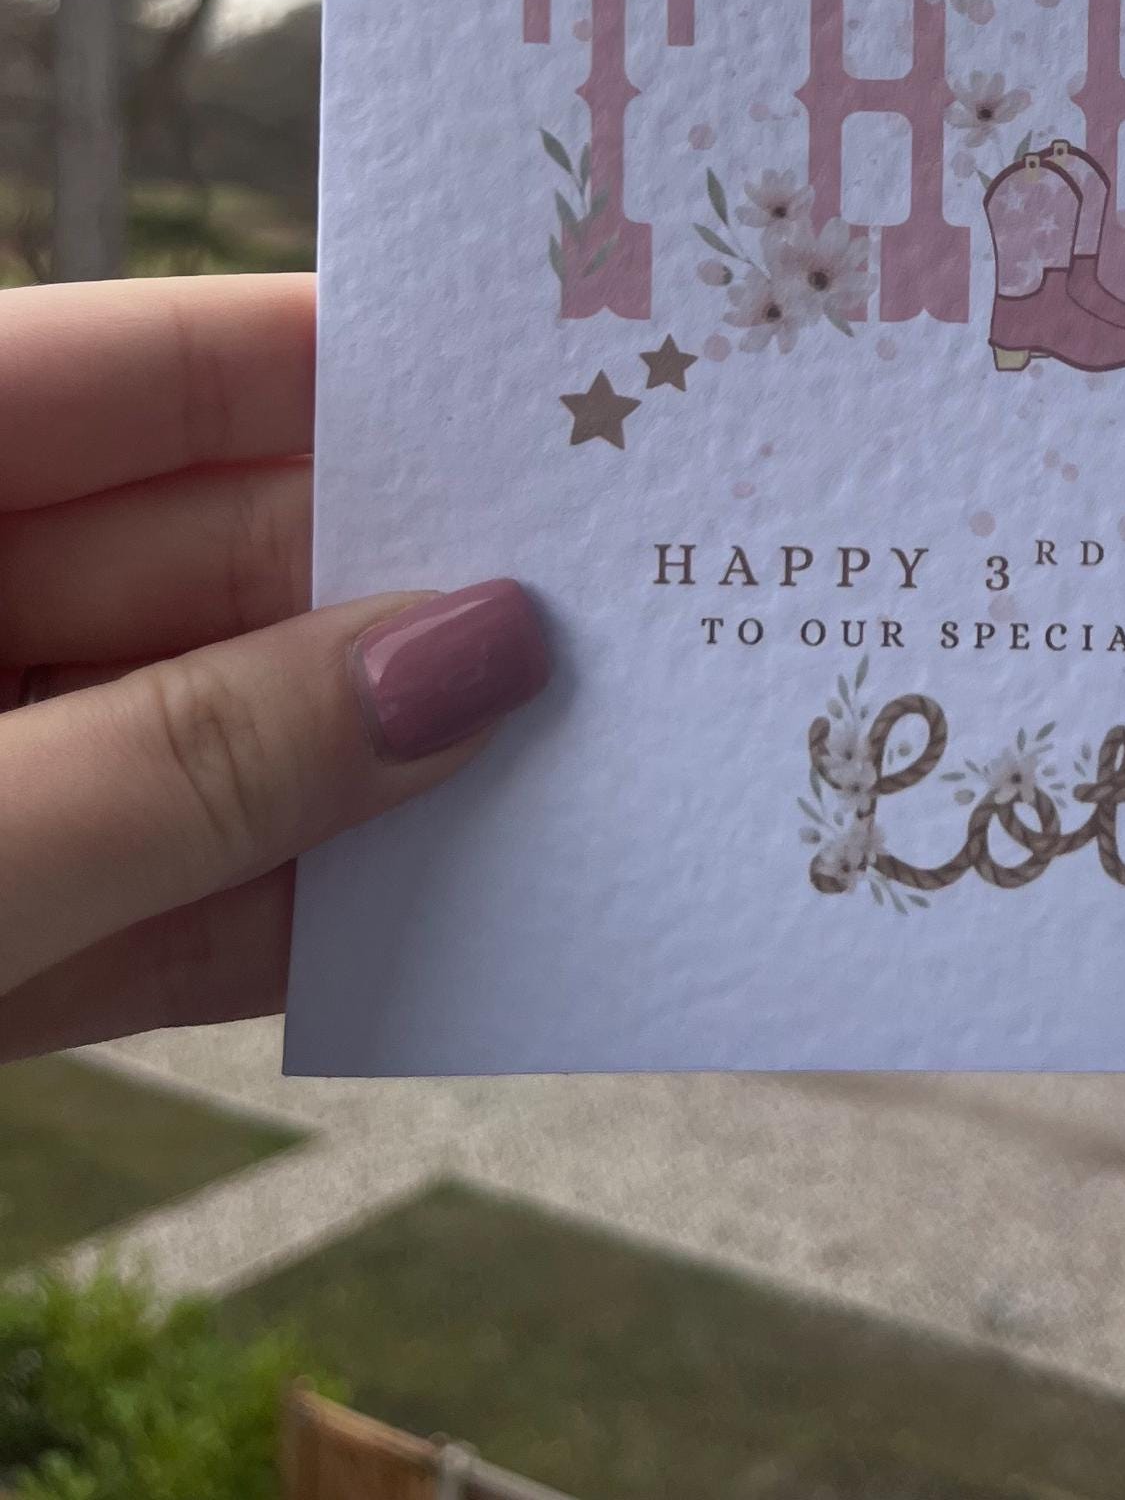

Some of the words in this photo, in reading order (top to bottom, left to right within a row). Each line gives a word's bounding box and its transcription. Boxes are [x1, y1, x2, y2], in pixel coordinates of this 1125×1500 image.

[652, 543, 931, 590] HAPPY
[985, 537, 1107, 592] 3RD
[700, 616, 767, 647] TO
[799, 618, 908, 650] OUR
